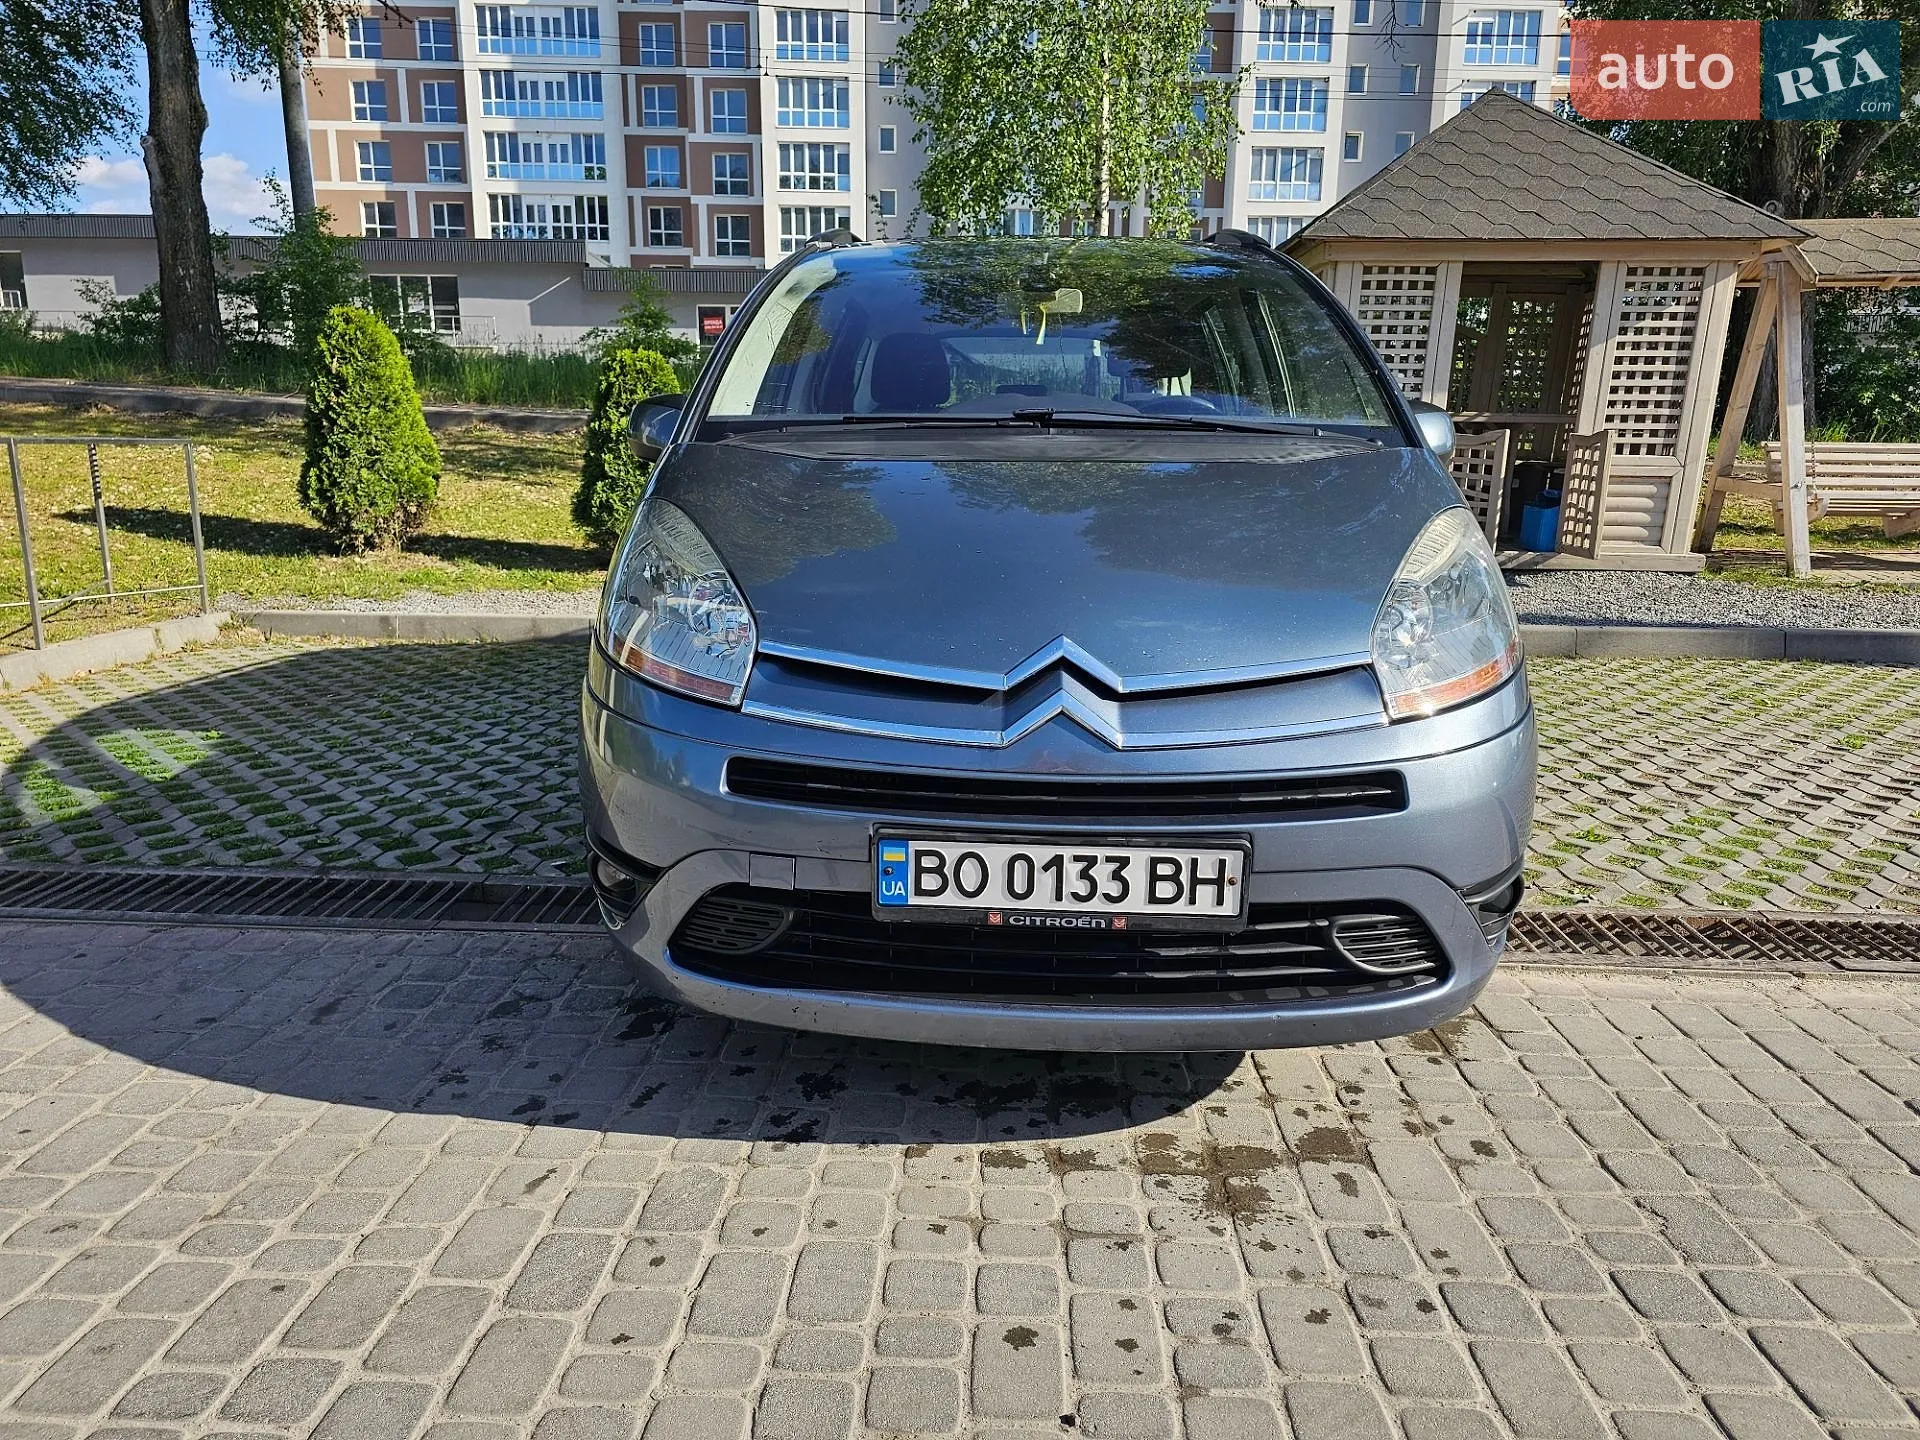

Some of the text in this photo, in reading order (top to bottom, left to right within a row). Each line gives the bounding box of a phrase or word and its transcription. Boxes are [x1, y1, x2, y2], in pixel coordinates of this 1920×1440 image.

[882, 880, 906, 896] UA
[914, 849, 1227, 907] BO 0133 BH
